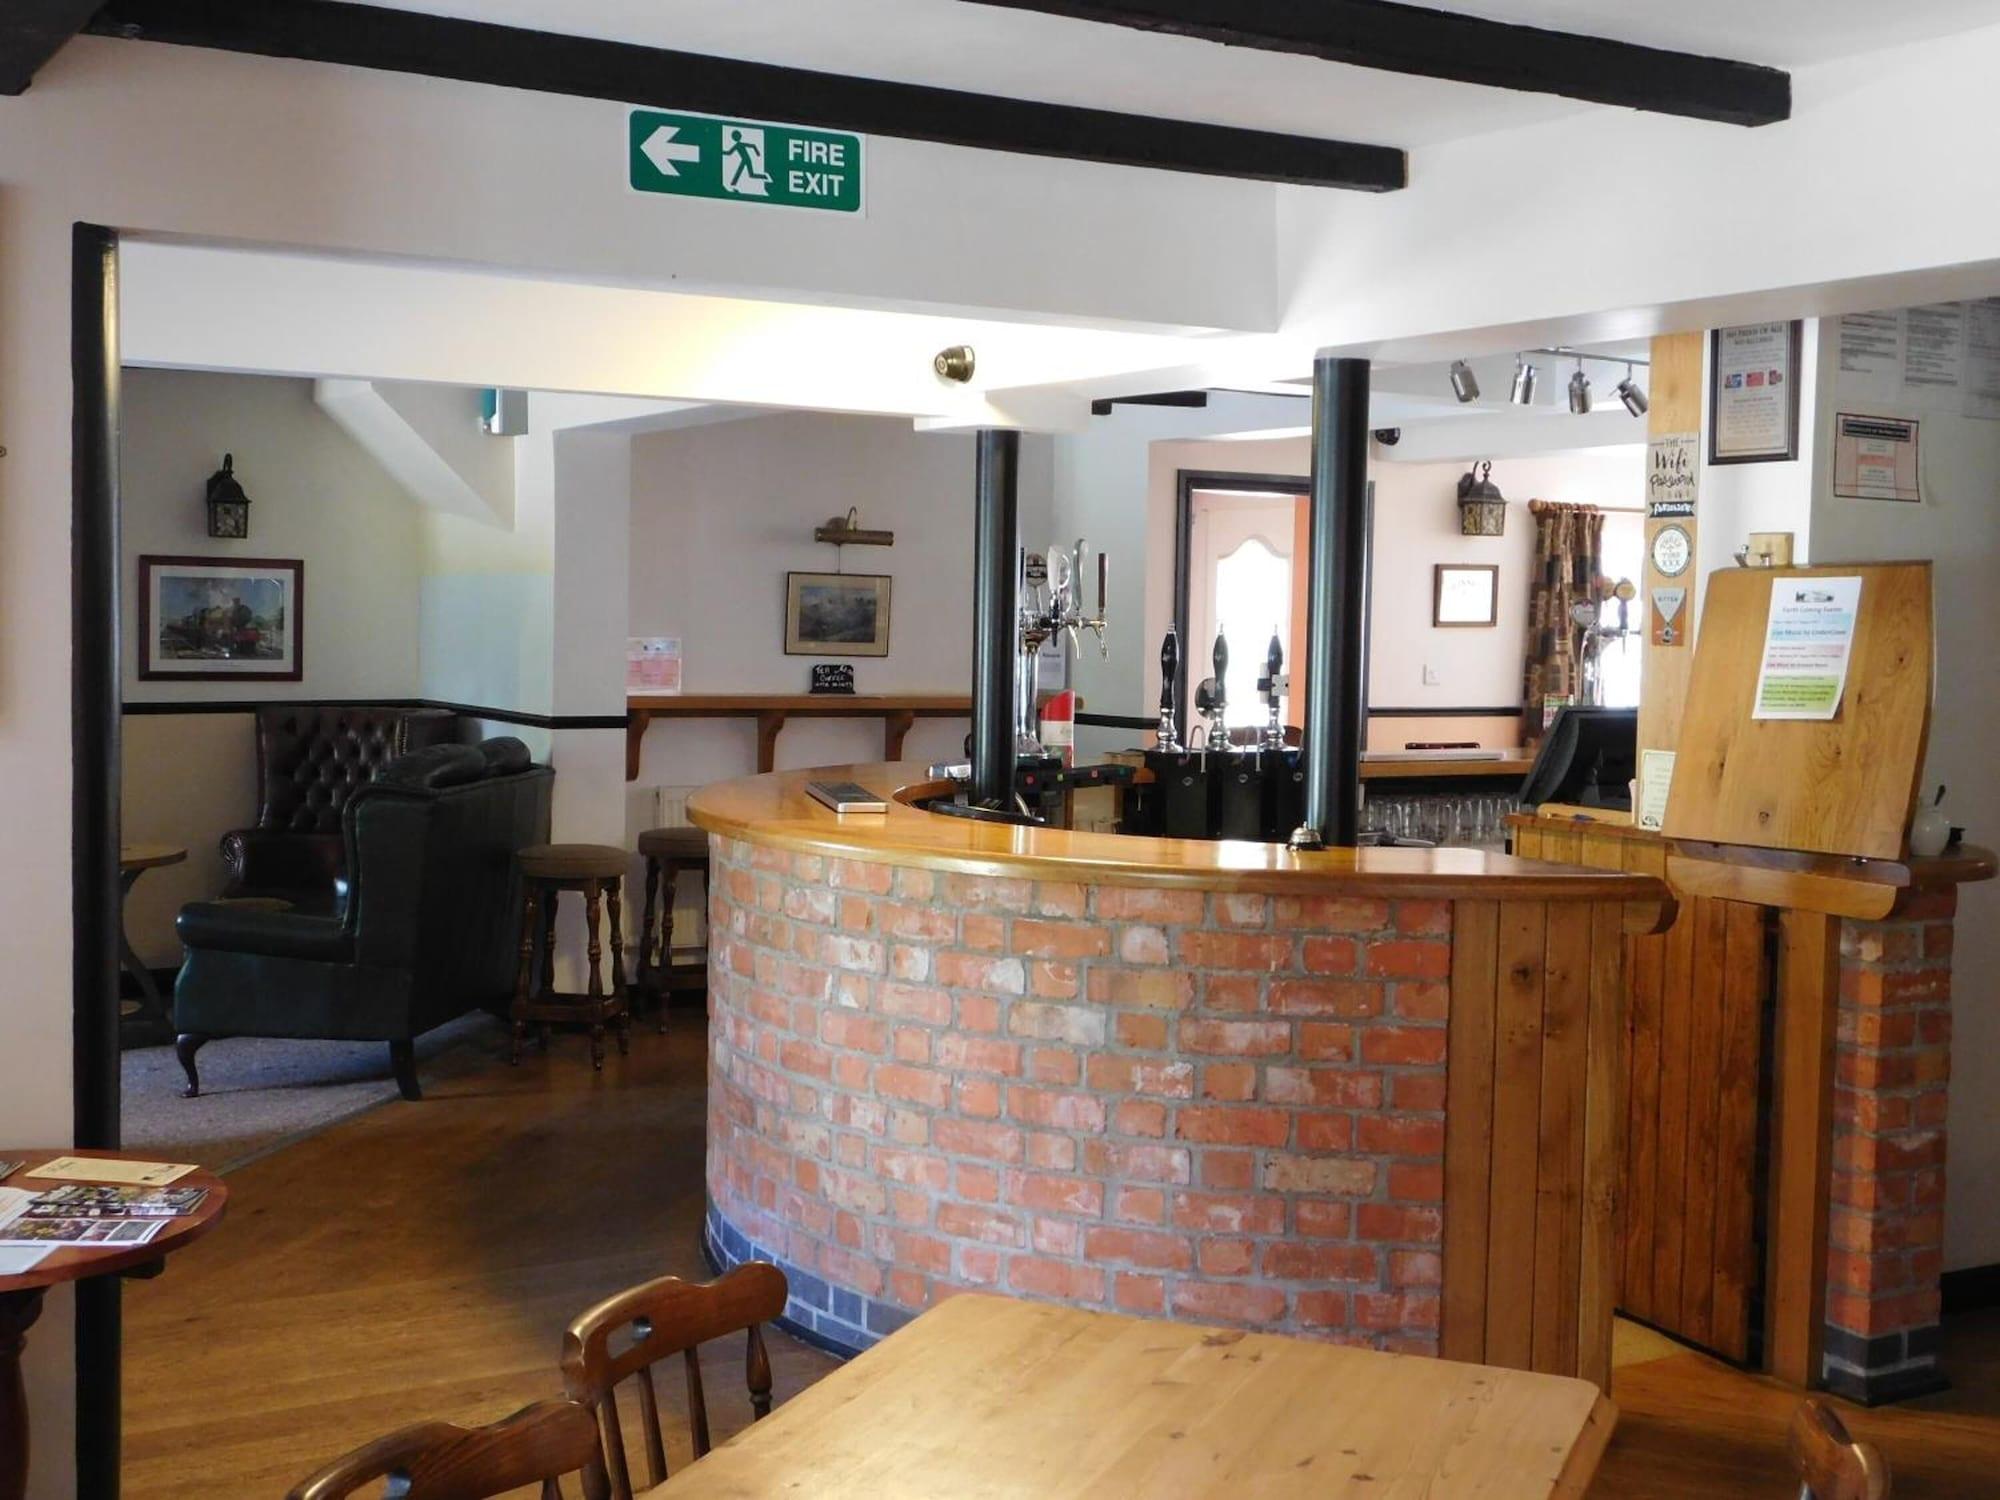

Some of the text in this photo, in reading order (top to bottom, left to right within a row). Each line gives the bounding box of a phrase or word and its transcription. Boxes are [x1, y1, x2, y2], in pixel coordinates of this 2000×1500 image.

[788, 138, 845, 167] FIRE
[788, 171, 844, 197] EXIT
[1665, 438, 1680, 448] THE
[1655, 447, 1688, 474] Wifi
